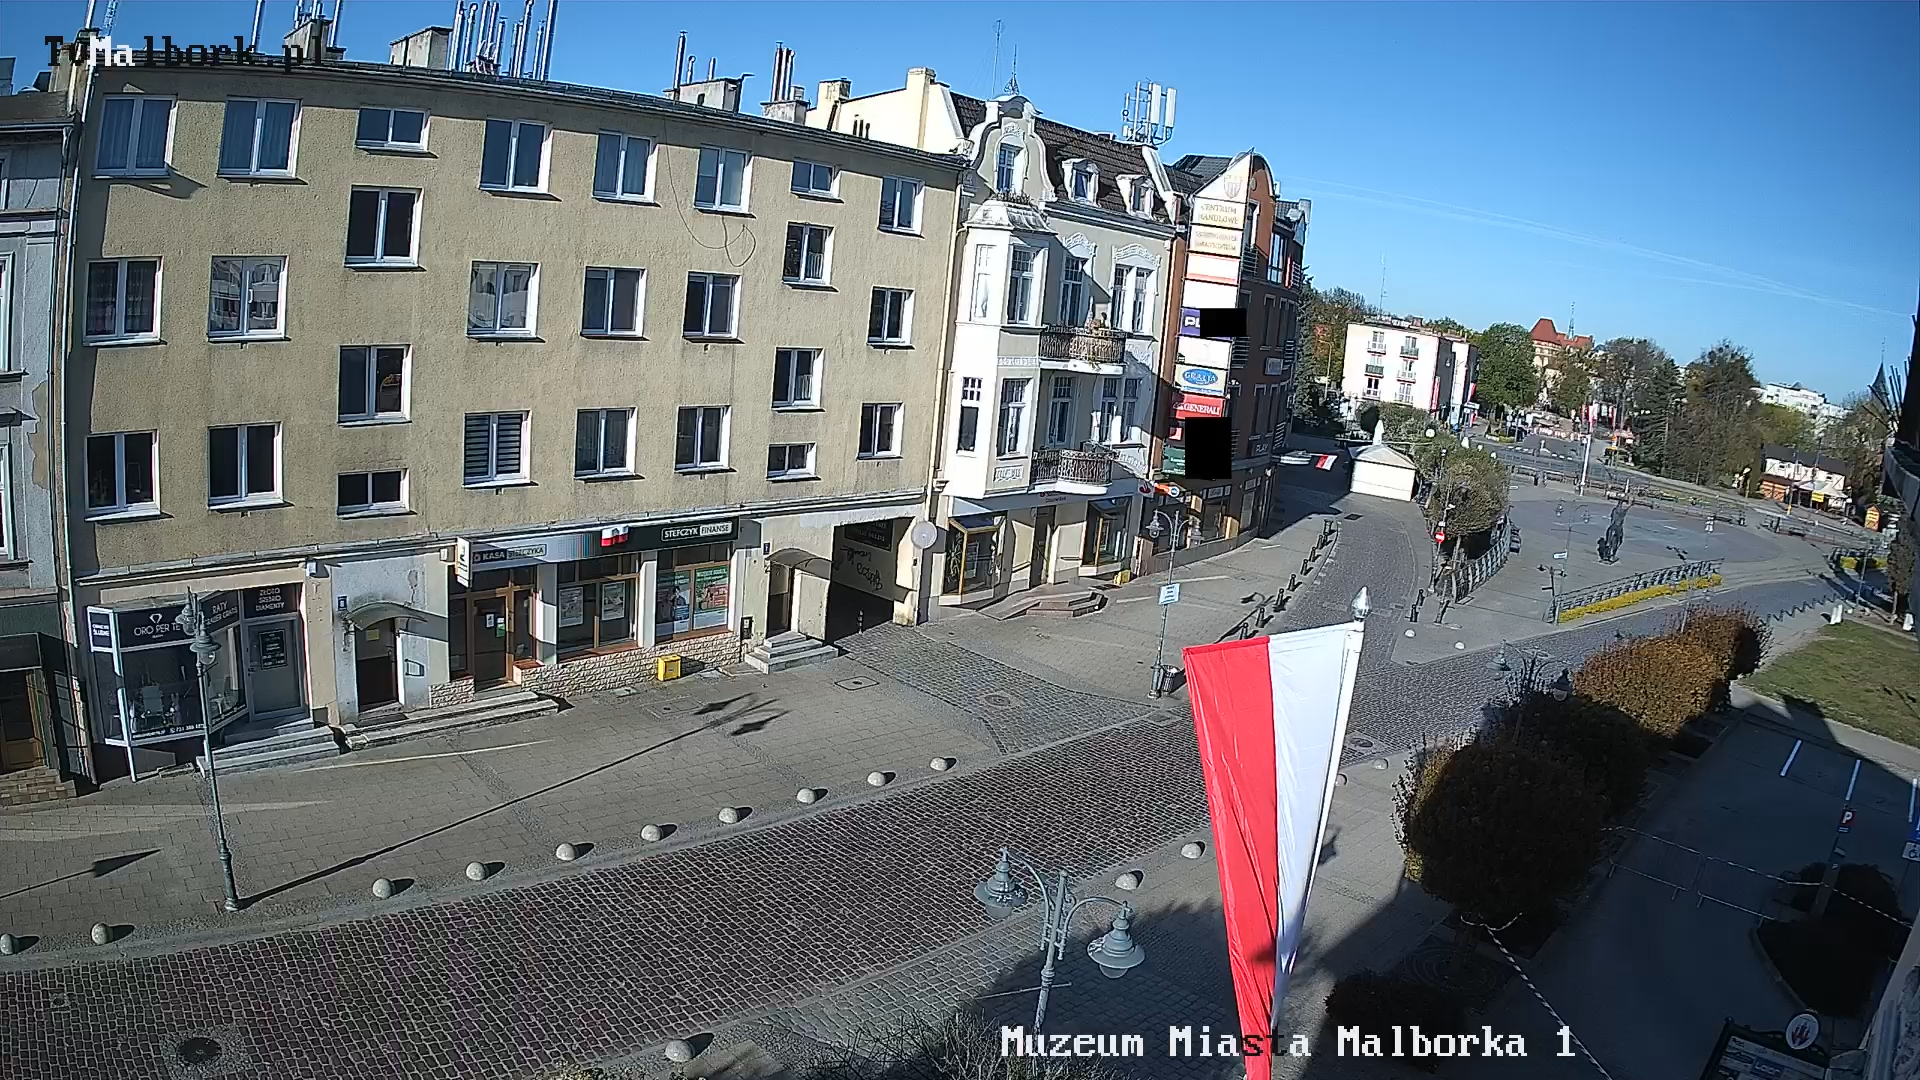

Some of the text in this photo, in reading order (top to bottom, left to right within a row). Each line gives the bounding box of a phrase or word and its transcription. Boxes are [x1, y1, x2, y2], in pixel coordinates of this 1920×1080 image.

[1184, 402, 1220, 415] GENERALI
[664, 524, 730, 539] STEFCZYK FINANSE
[482, 551, 506, 561] KASA
[212, 600, 228, 614] RATY
[133, 625, 154, 636] ORO
[155, 623, 170, 633] PER
[1842, 811, 1853, 824] P
